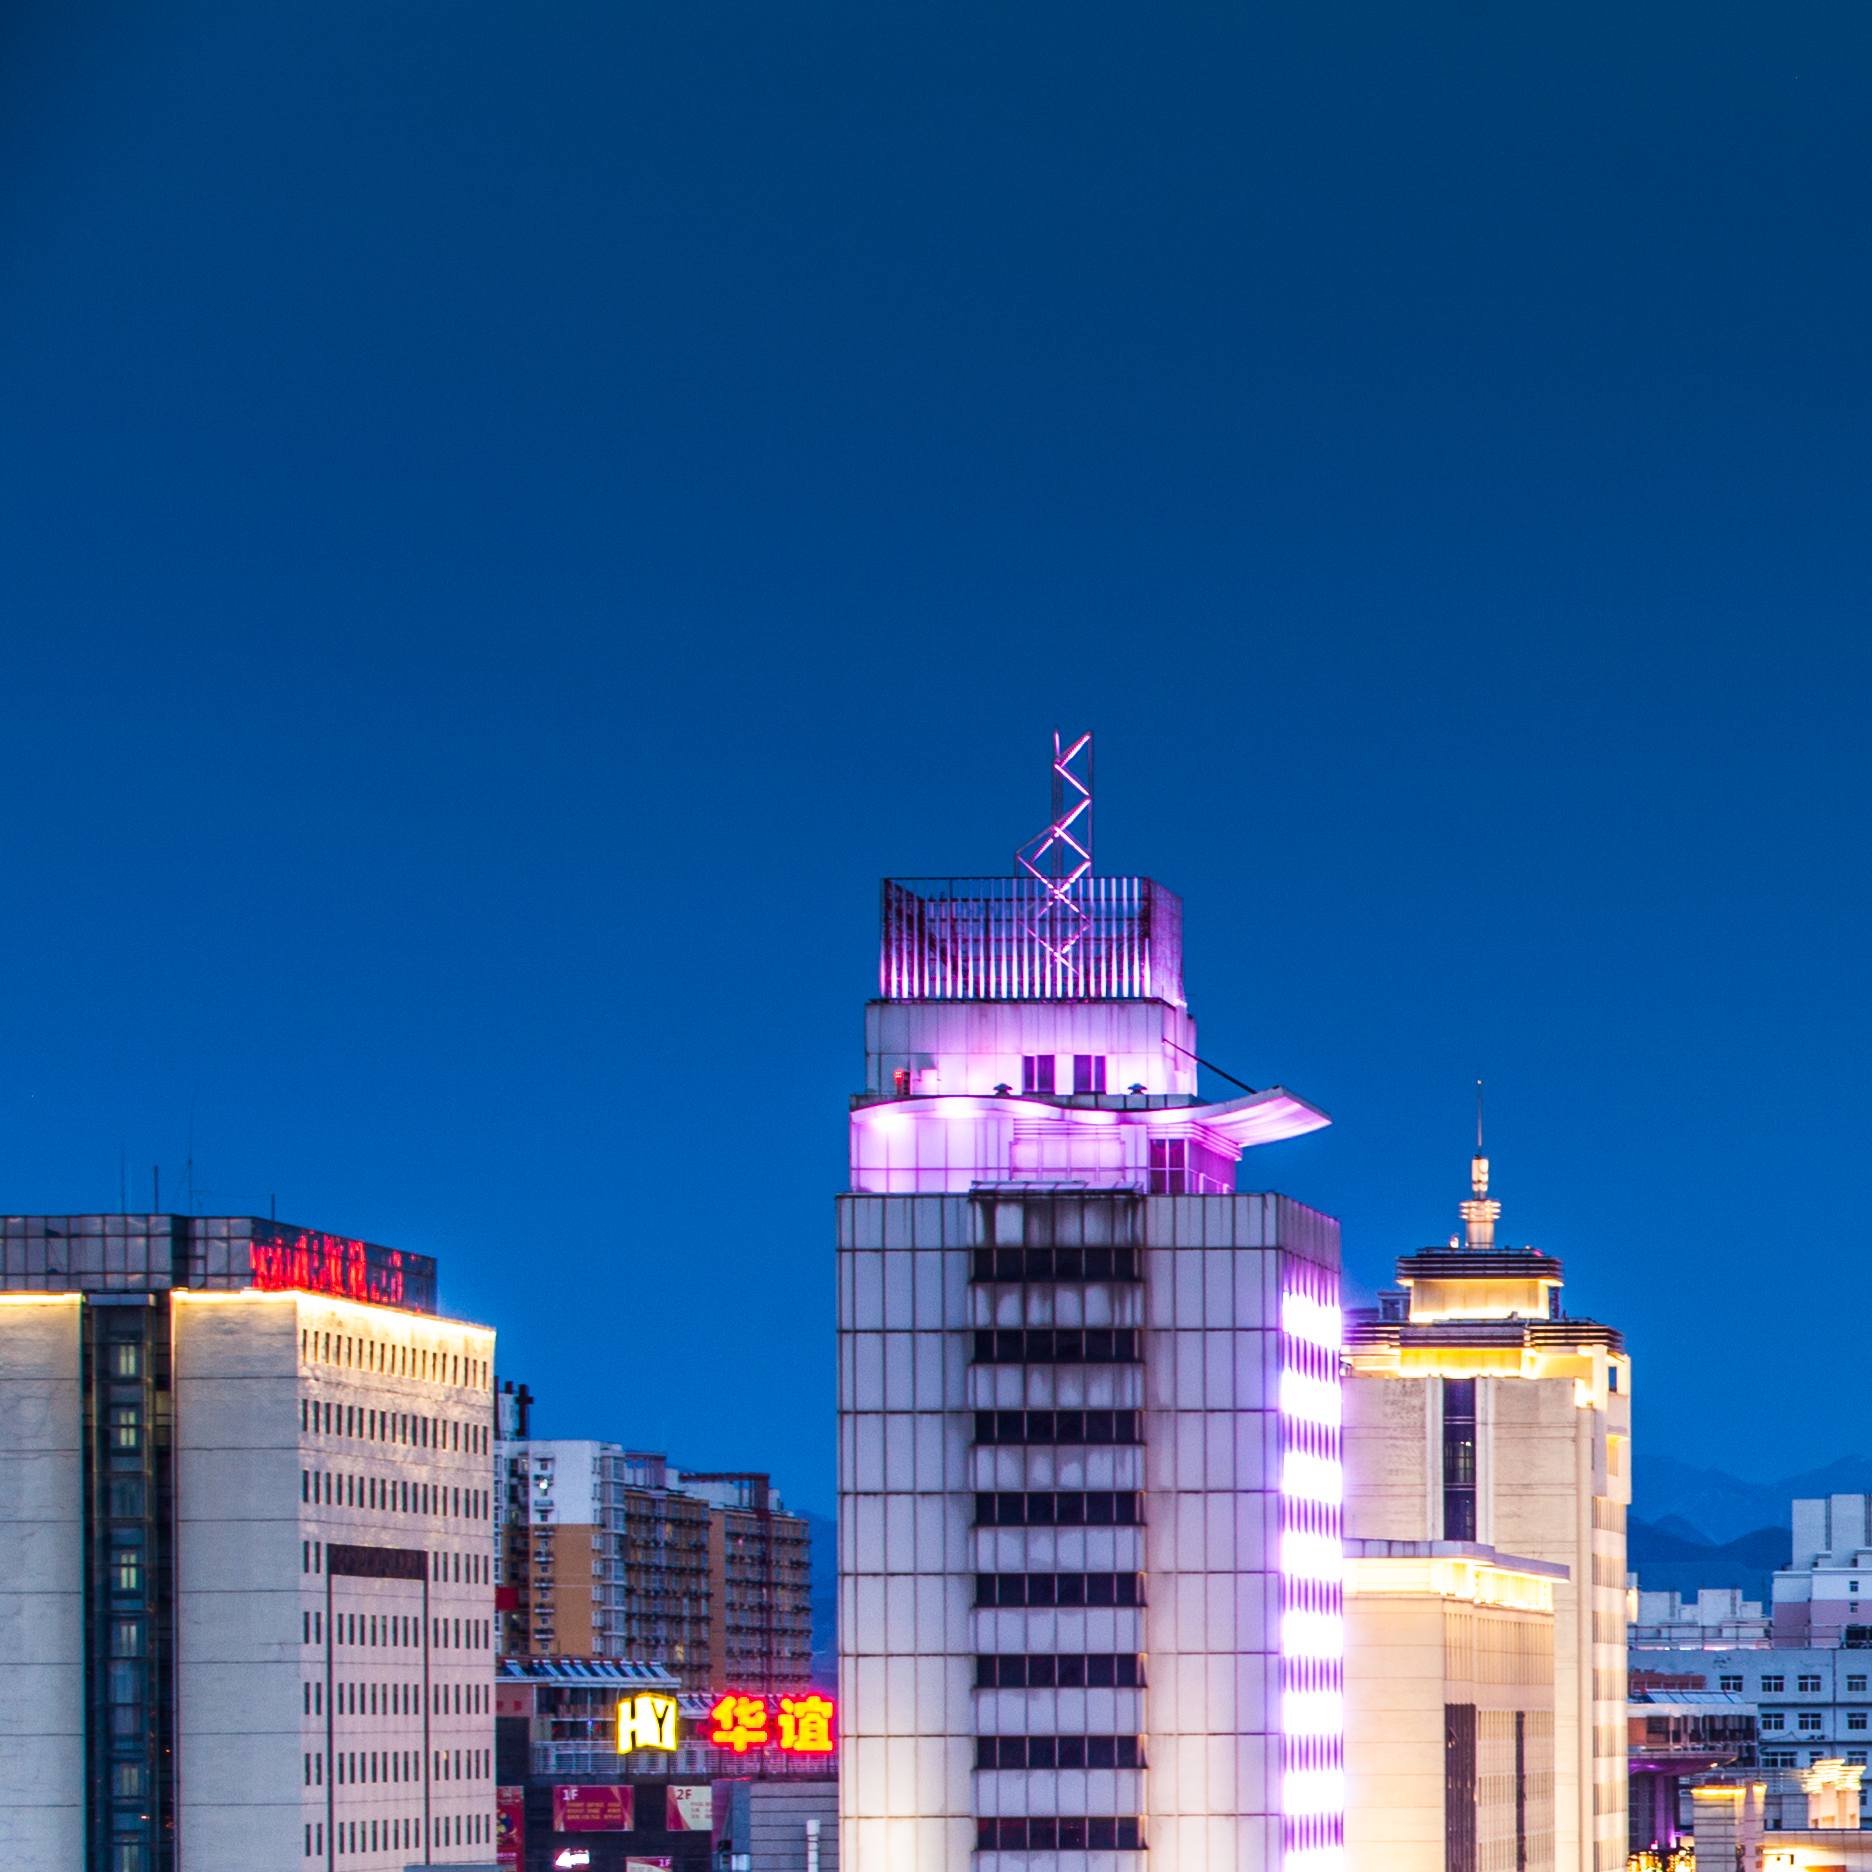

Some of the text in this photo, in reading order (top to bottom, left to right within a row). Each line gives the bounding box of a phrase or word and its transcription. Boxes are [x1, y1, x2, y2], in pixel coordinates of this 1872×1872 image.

[617, 1692, 678, 1754] HY
[711, 1691, 836, 1754] 华谊
[562, 1789, 579, 1801] 1F
[676, 1789, 692, 1800] 2F
